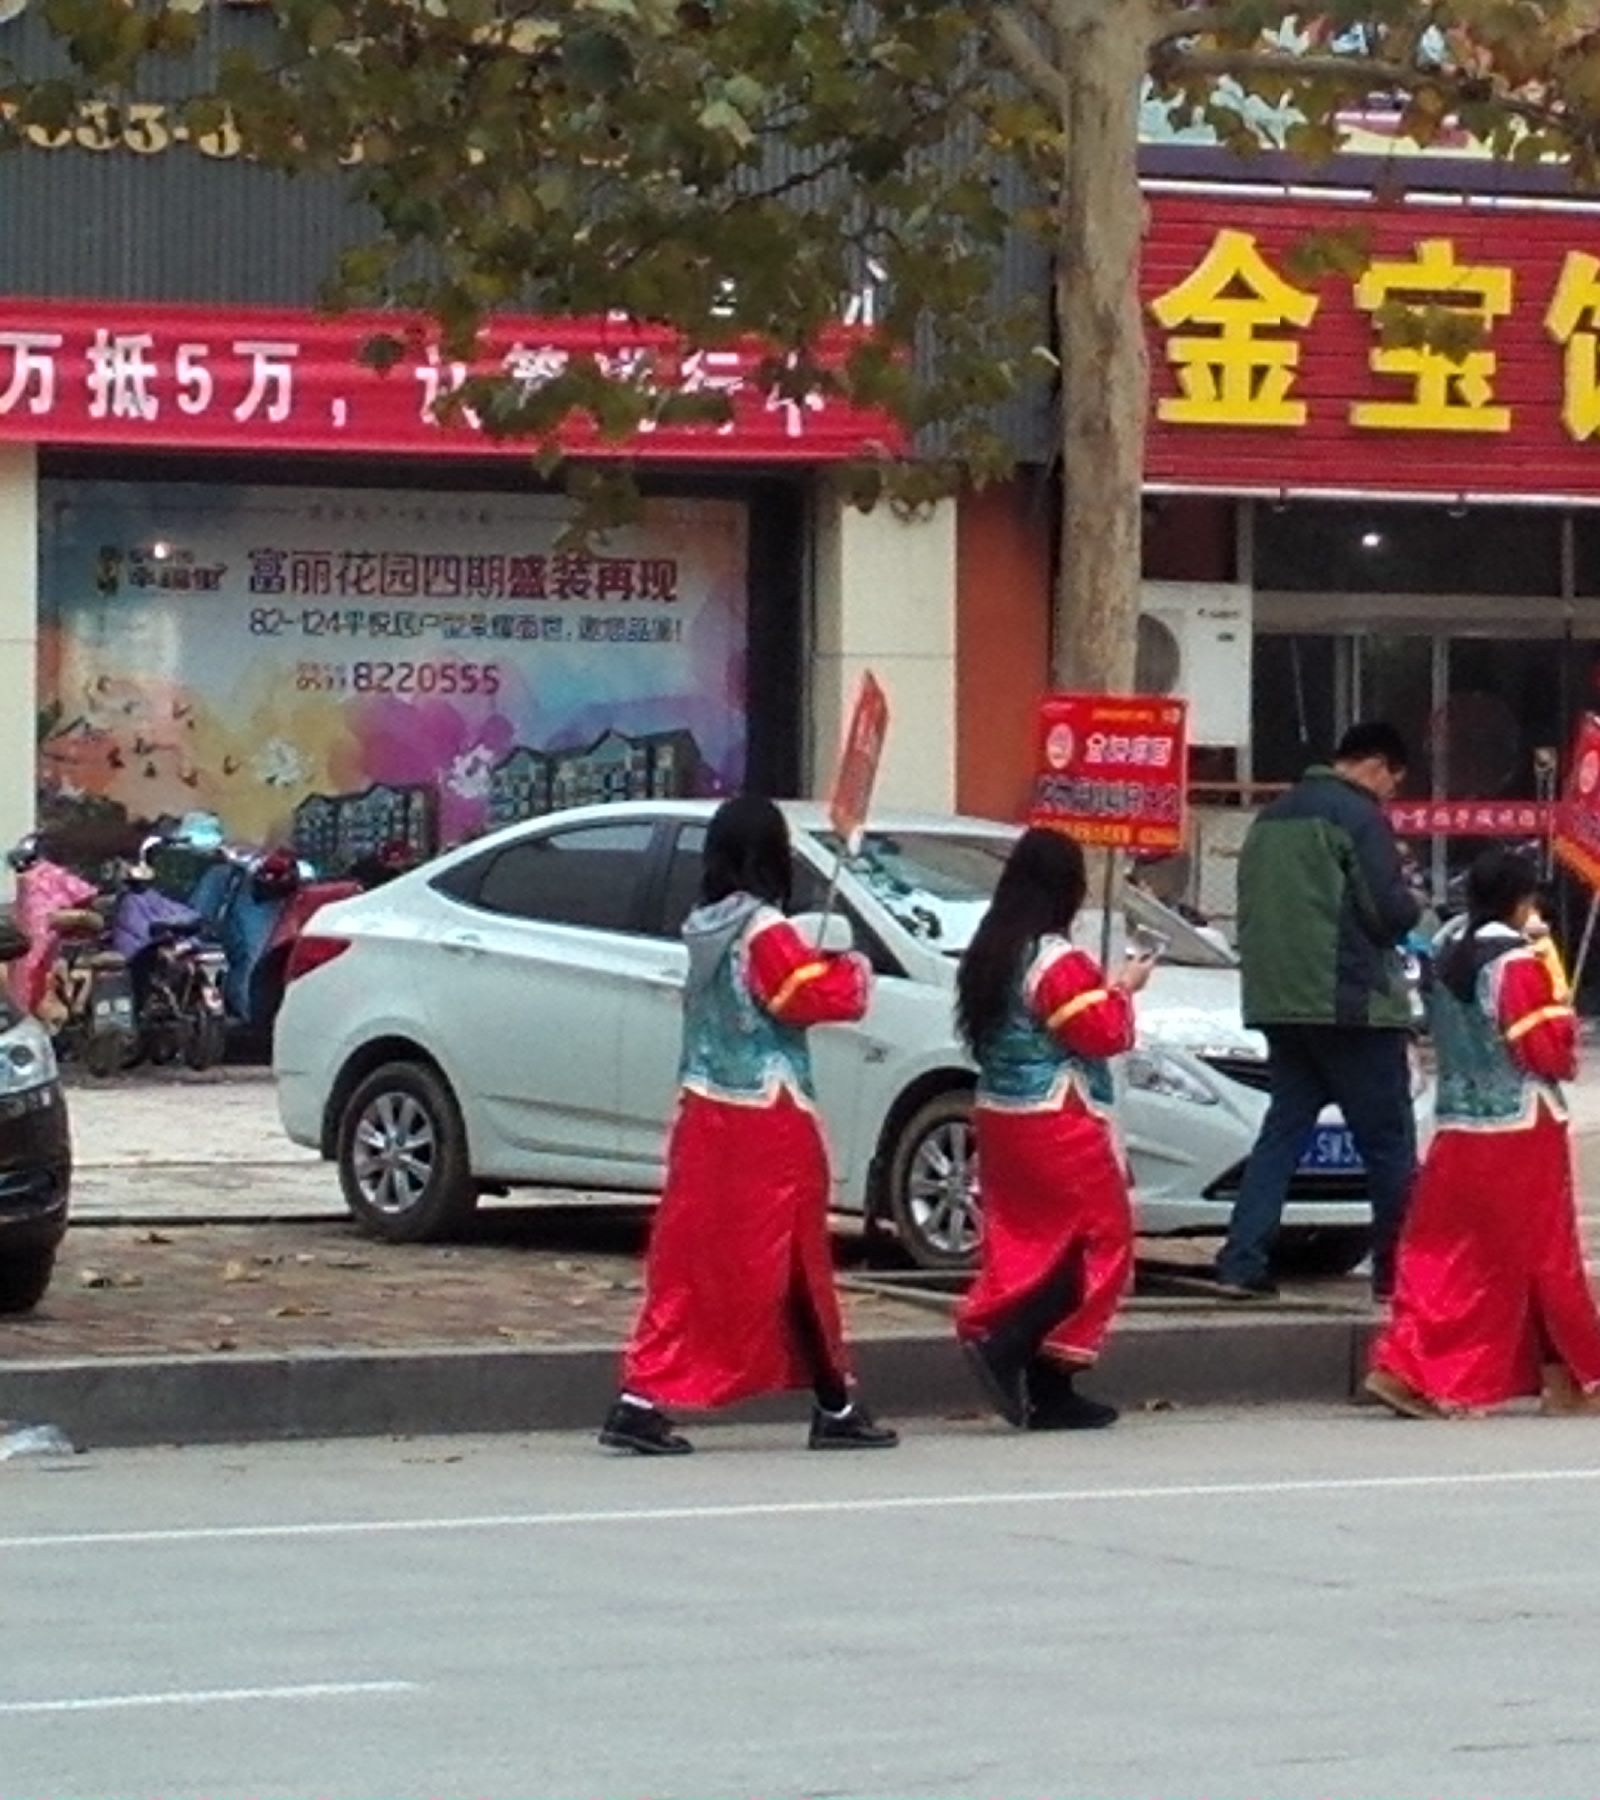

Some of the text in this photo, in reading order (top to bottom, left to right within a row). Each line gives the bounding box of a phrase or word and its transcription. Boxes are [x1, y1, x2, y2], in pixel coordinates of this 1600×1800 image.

[247, 548, 679, 602] 富丽花园四期盛装再现
[353, 661, 500, 694] 8220555
